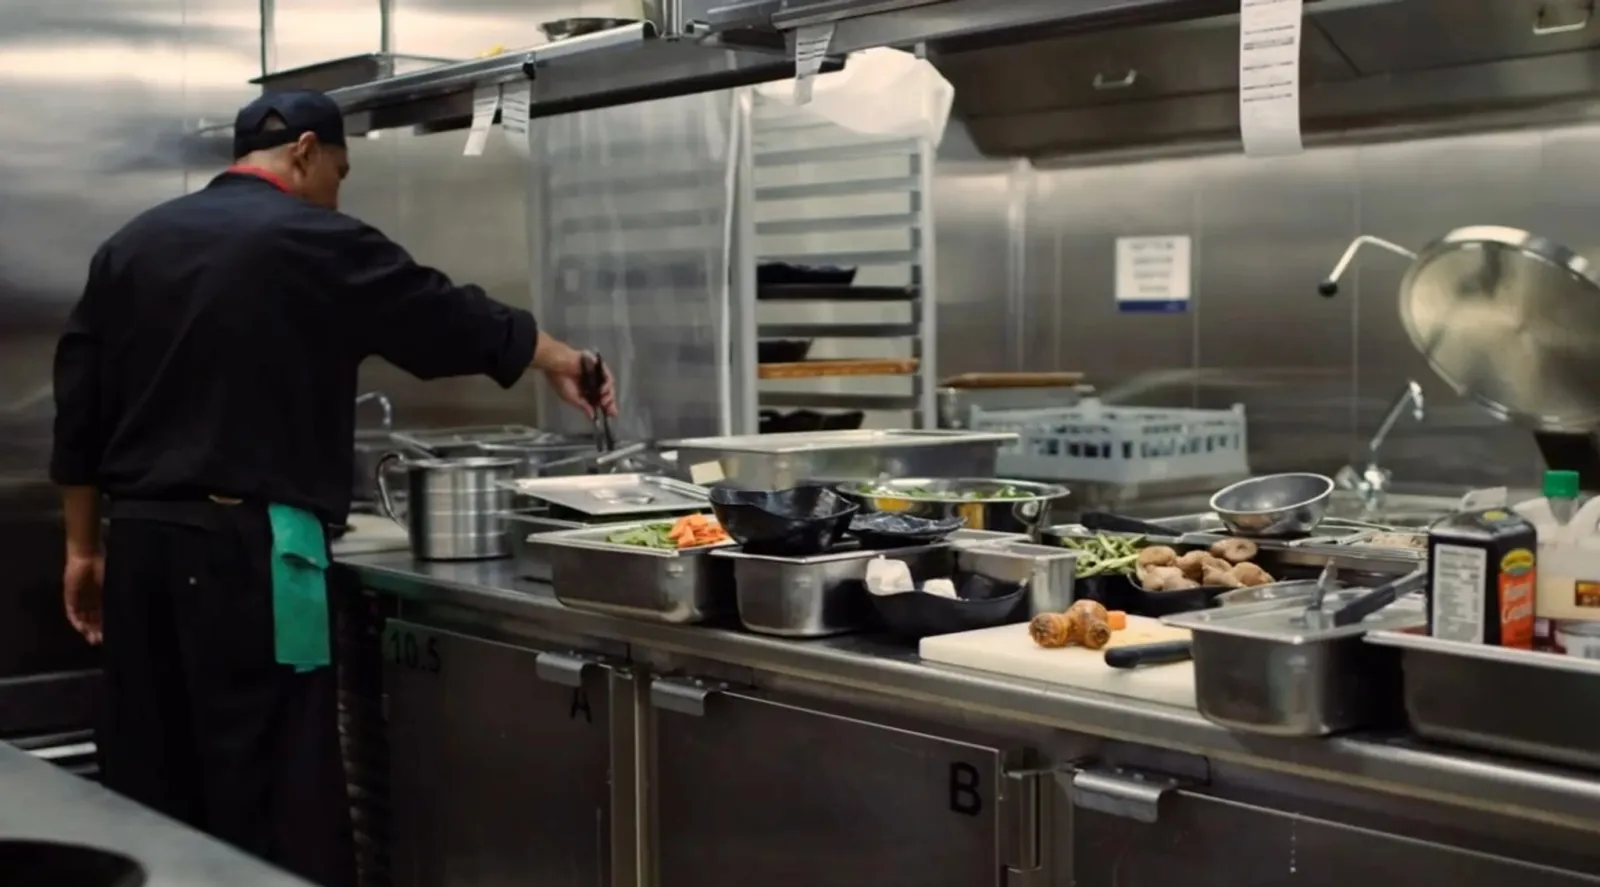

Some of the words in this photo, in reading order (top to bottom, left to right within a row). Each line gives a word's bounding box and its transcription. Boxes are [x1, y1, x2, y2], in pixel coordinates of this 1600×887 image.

[390, 628, 441, 673] 10.5
[570, 688, 592, 724] A
[950, 761, 982, 816] B
